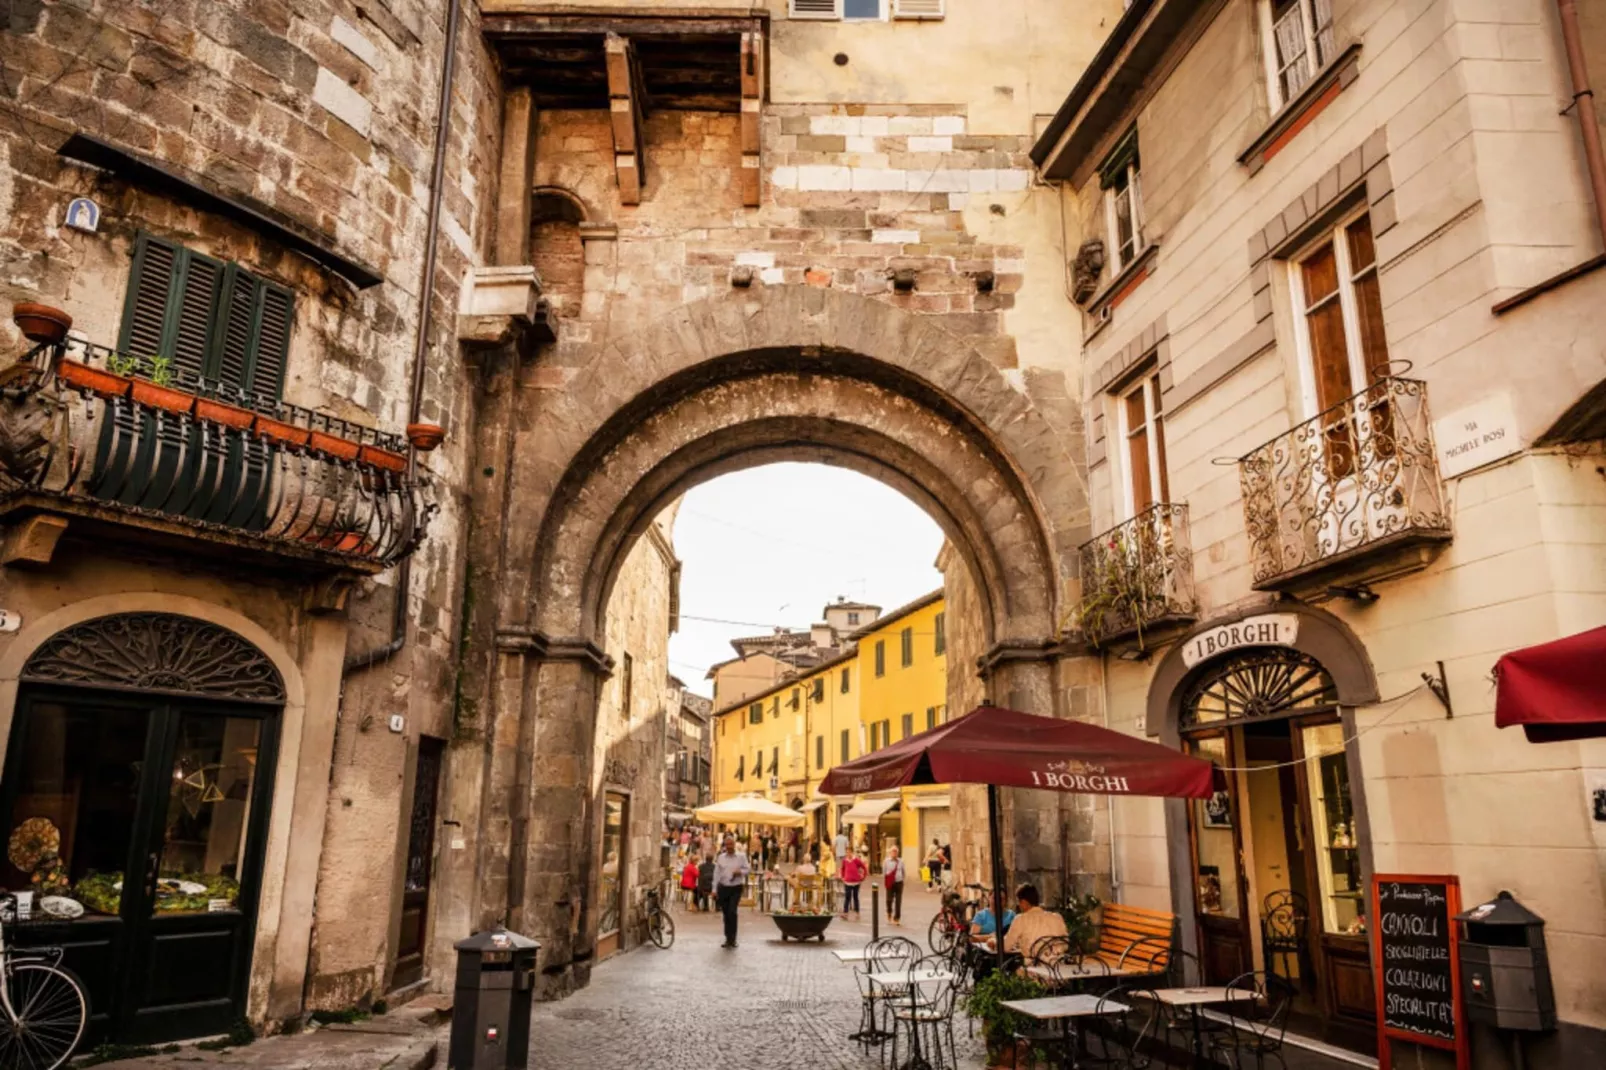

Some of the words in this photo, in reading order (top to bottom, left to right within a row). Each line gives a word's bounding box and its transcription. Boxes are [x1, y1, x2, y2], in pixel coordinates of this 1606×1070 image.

[1196, 640, 1204, 658] I
[1205, 622, 1279, 655] BORGHI
[1031, 771, 1041, 785] I
[1044, 772, 1130, 791] BORGHI
[1381, 912, 1438, 936] CANNOLI
[1385, 967, 1447, 992] COLAZIONI
